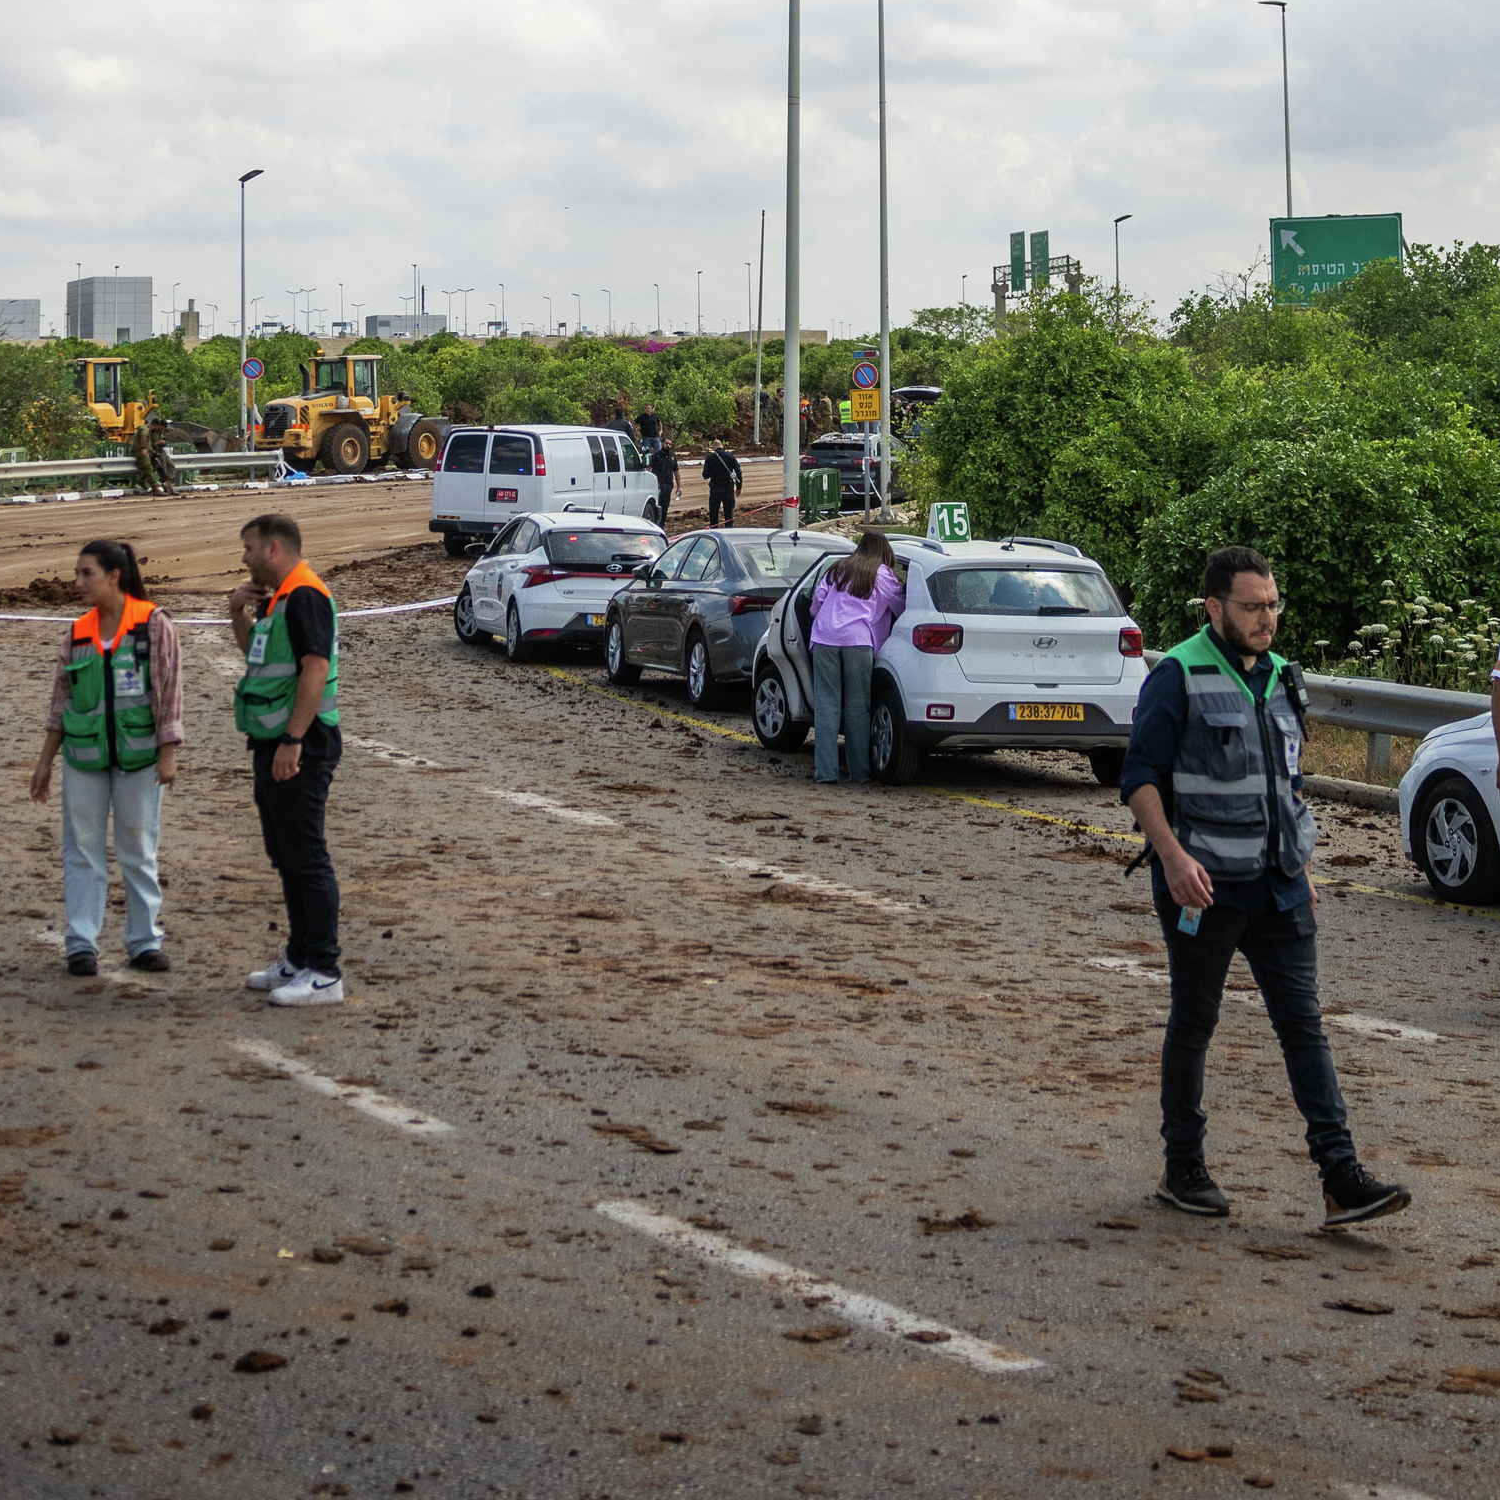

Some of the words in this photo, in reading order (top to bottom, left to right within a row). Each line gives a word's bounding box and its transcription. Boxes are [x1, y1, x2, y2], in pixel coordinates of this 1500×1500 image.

[1297, 263, 1345, 276] הטיסות
[854, 410, 877, 418] מוגדל
[938, 507, 969, 536] 15
